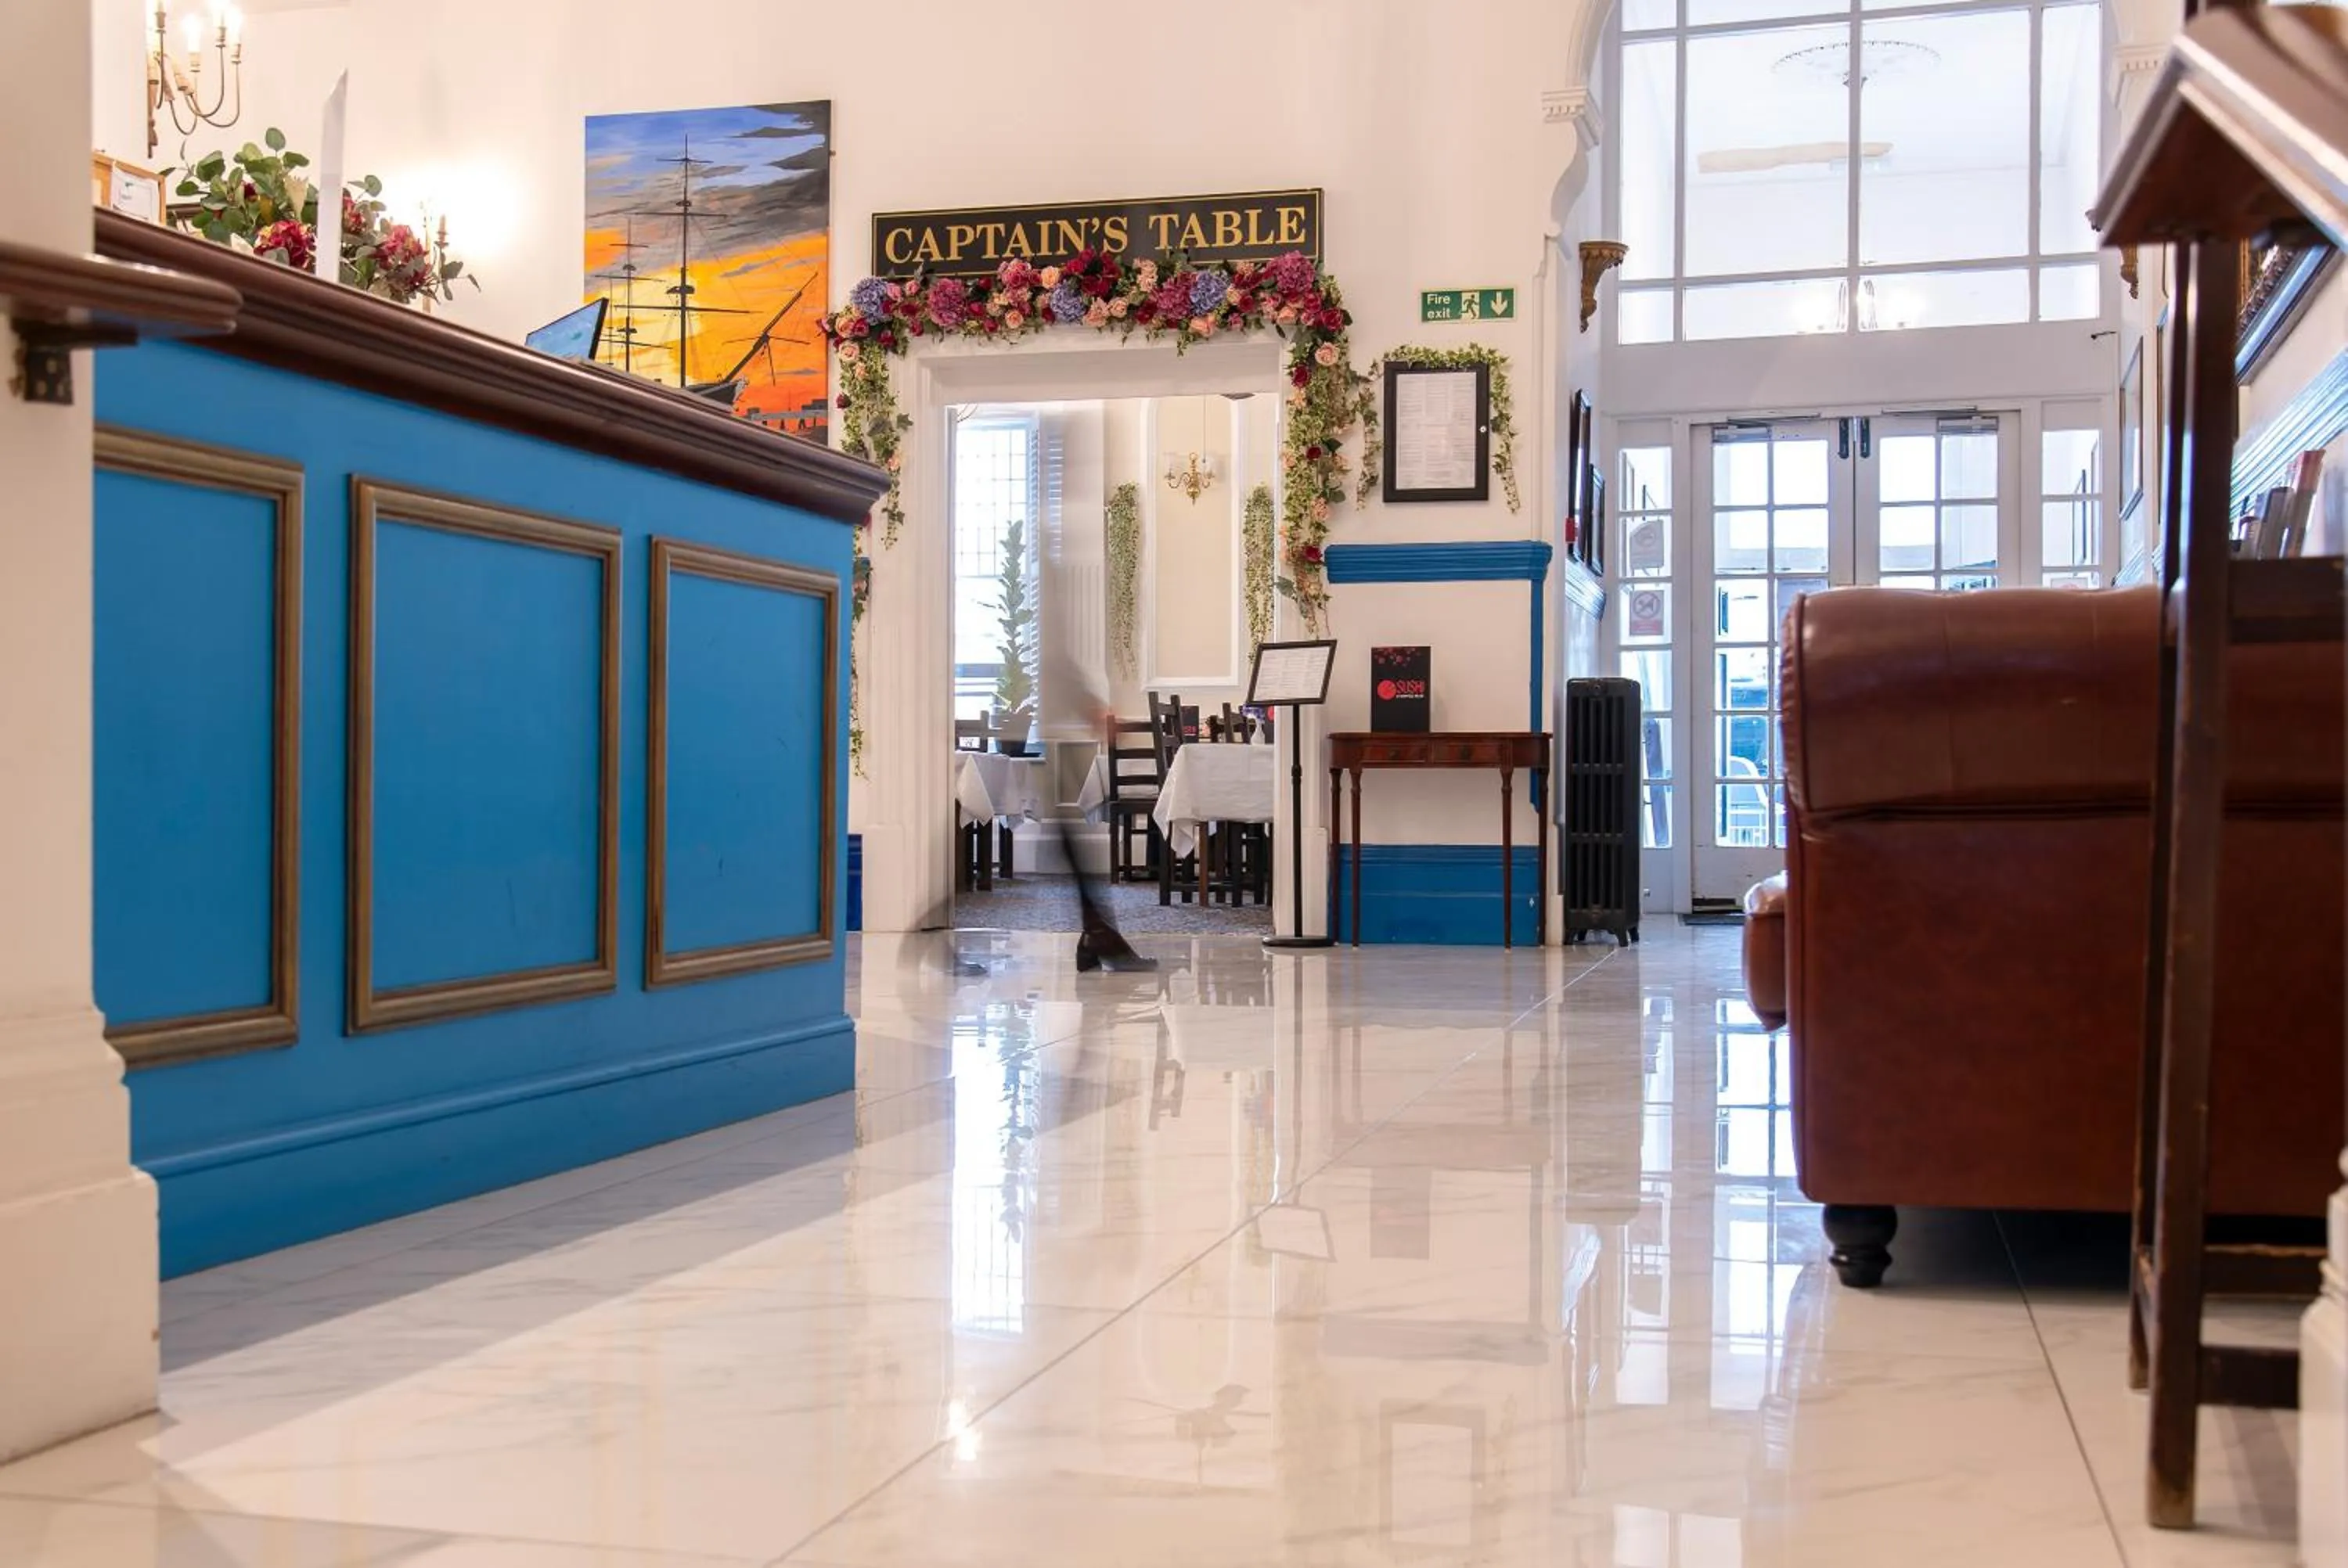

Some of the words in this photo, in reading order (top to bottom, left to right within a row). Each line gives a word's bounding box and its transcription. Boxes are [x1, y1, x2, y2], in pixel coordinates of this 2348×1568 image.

[885, 216, 1129, 264] CAPTAIN'S
[1148, 206, 1305, 250] TABLE
[1427, 293, 1450, 305] Fire
[1427, 307, 1450, 319] exit
